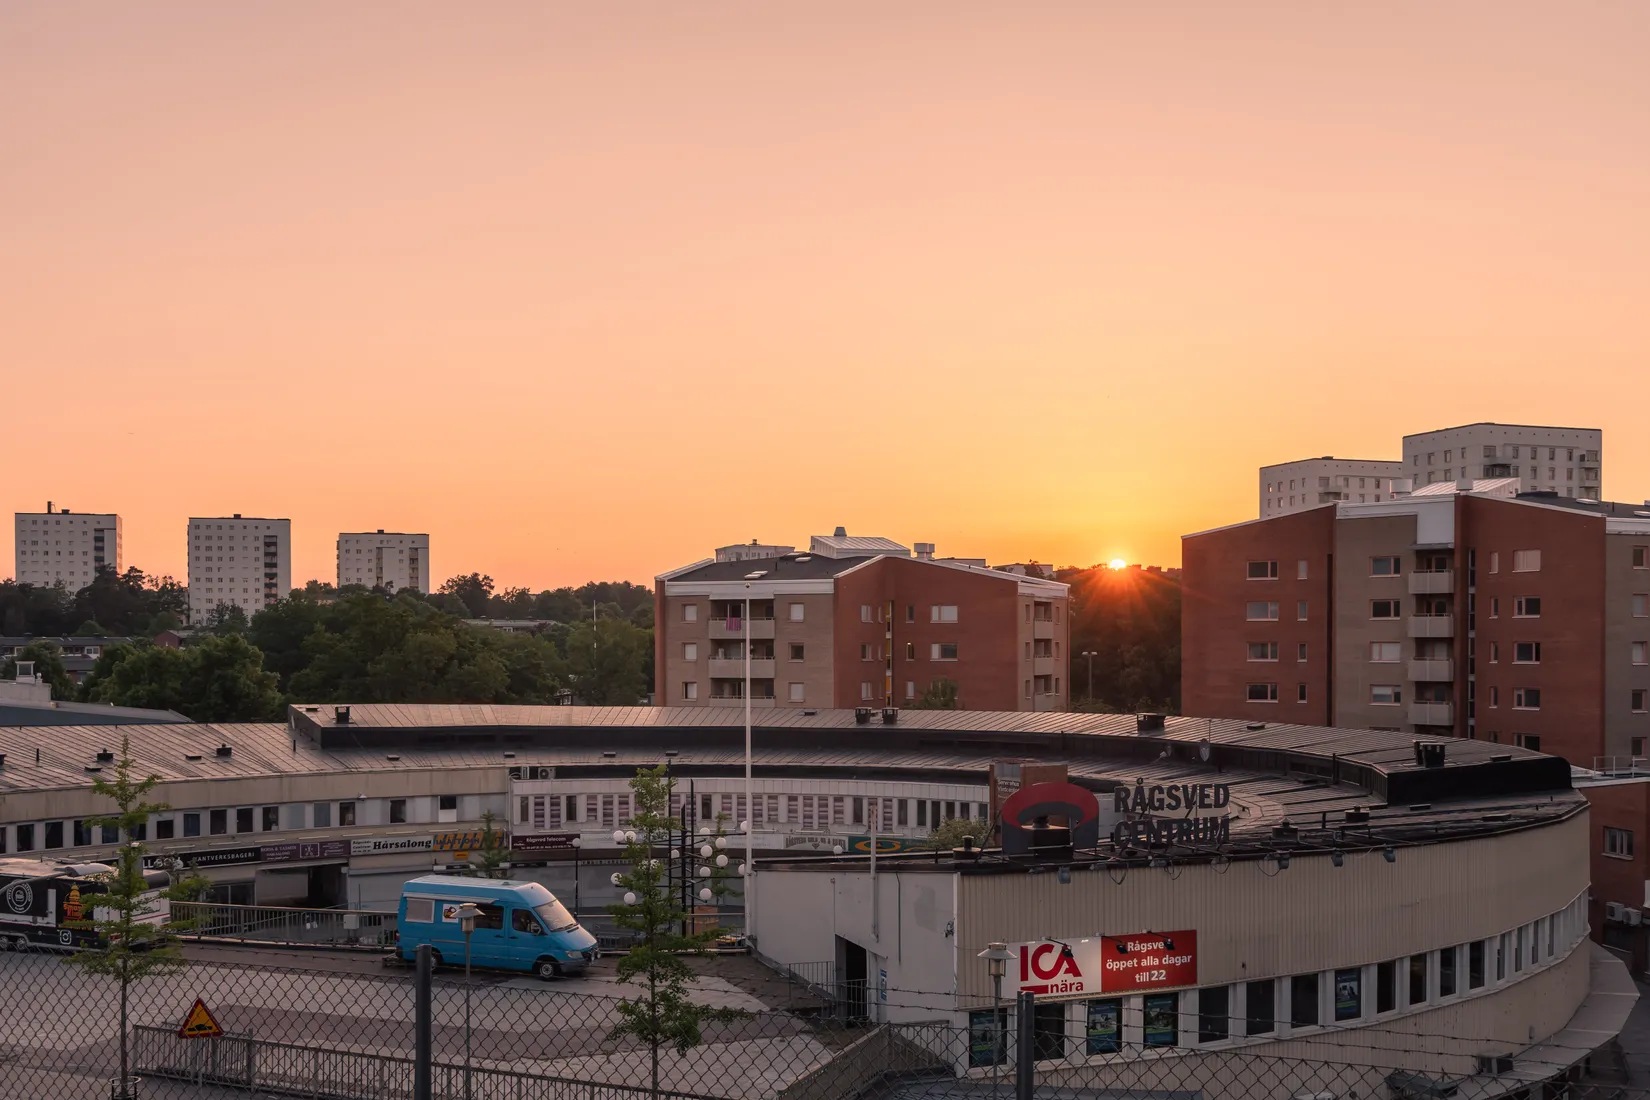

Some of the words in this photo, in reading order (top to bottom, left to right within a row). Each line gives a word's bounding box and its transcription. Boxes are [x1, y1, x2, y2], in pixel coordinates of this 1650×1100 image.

[1114, 778, 1230, 813] RÅGSVED
[1114, 815, 1230, 848] CENTRUM
[373, 840, 432, 850] Hårsalong
[192, 852, 255, 862] ANTVERKSBAGERI
[1127, 940, 1168, 953] Rågsve
[1020, 943, 1083, 982] ICA
[1106, 957, 1138, 971] öppet
[1141, 955, 1159, 967] alla
[1162, 953, 1192, 967] dagar
[1135, 972, 1149, 983] till
[1150, 970, 1167, 981] 22
[1050, 980, 1084, 994] nära
